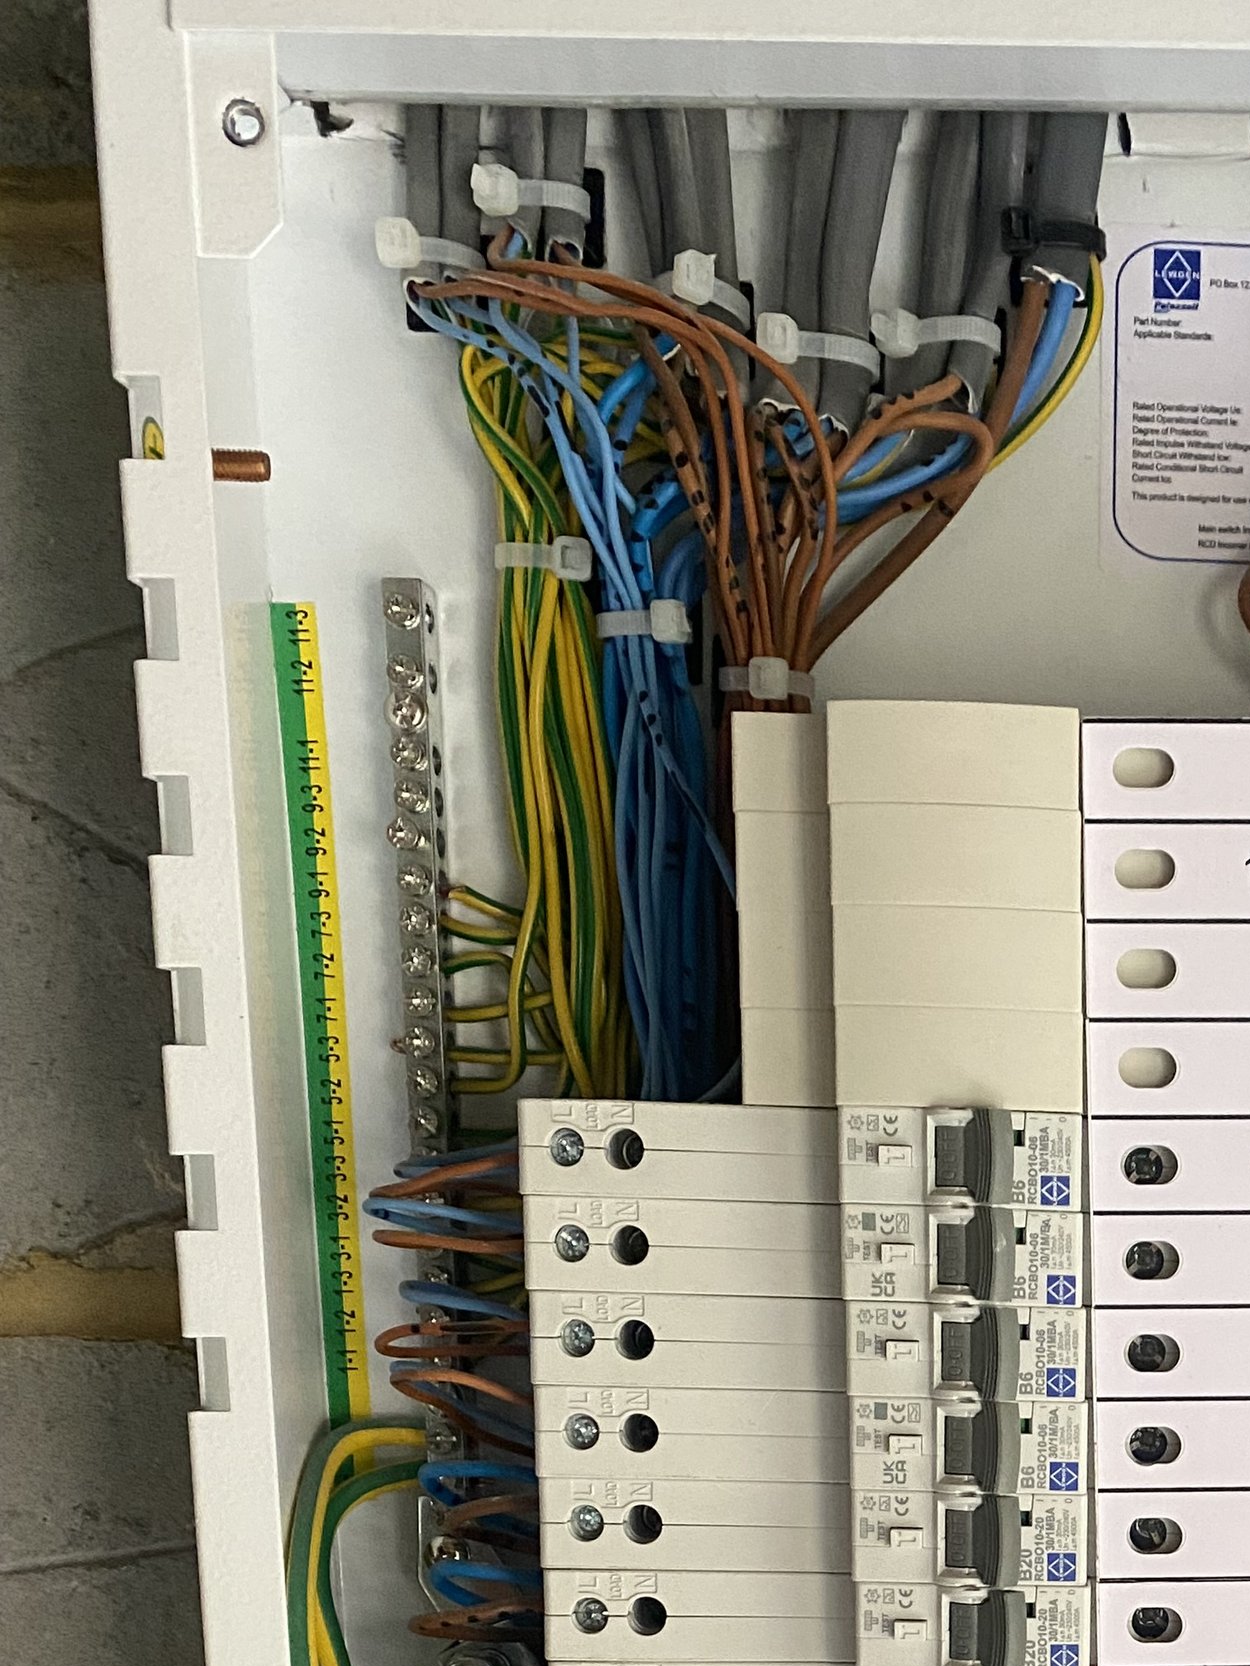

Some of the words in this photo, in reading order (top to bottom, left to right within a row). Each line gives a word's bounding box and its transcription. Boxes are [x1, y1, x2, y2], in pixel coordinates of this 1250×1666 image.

[285, 609, 311, 646] 11-3
[291, 660, 315, 694] 11-2
[297, 739, 321, 771] 11-1
[301, 783, 323, 812] 9-3
[304, 827, 327, 857] 9-2
[308, 871, 329, 898] 9-1
[311, 910, 332, 938] 7-3
[314, 952, 335, 980] 7-2
[316, 998, 338, 1022] 7-1
[318, 1035, 339, 1063] 5-3
[321, 1078, 343, 1105] 5-2
[323, 1119, 345, 1145] 5-1
[325, 1156, 346, 1182] 3-3
[327, 1194, 350, 1221] 3-2
[331, 1235, 351, 1260] 3-1
[331, 1270, 353, 1295] 1-3
[336, 1309, 357, 1334] 1-2
[339, 1349, 359, 1372] 1-1
[1020, 1466, 1035, 1488] B6
